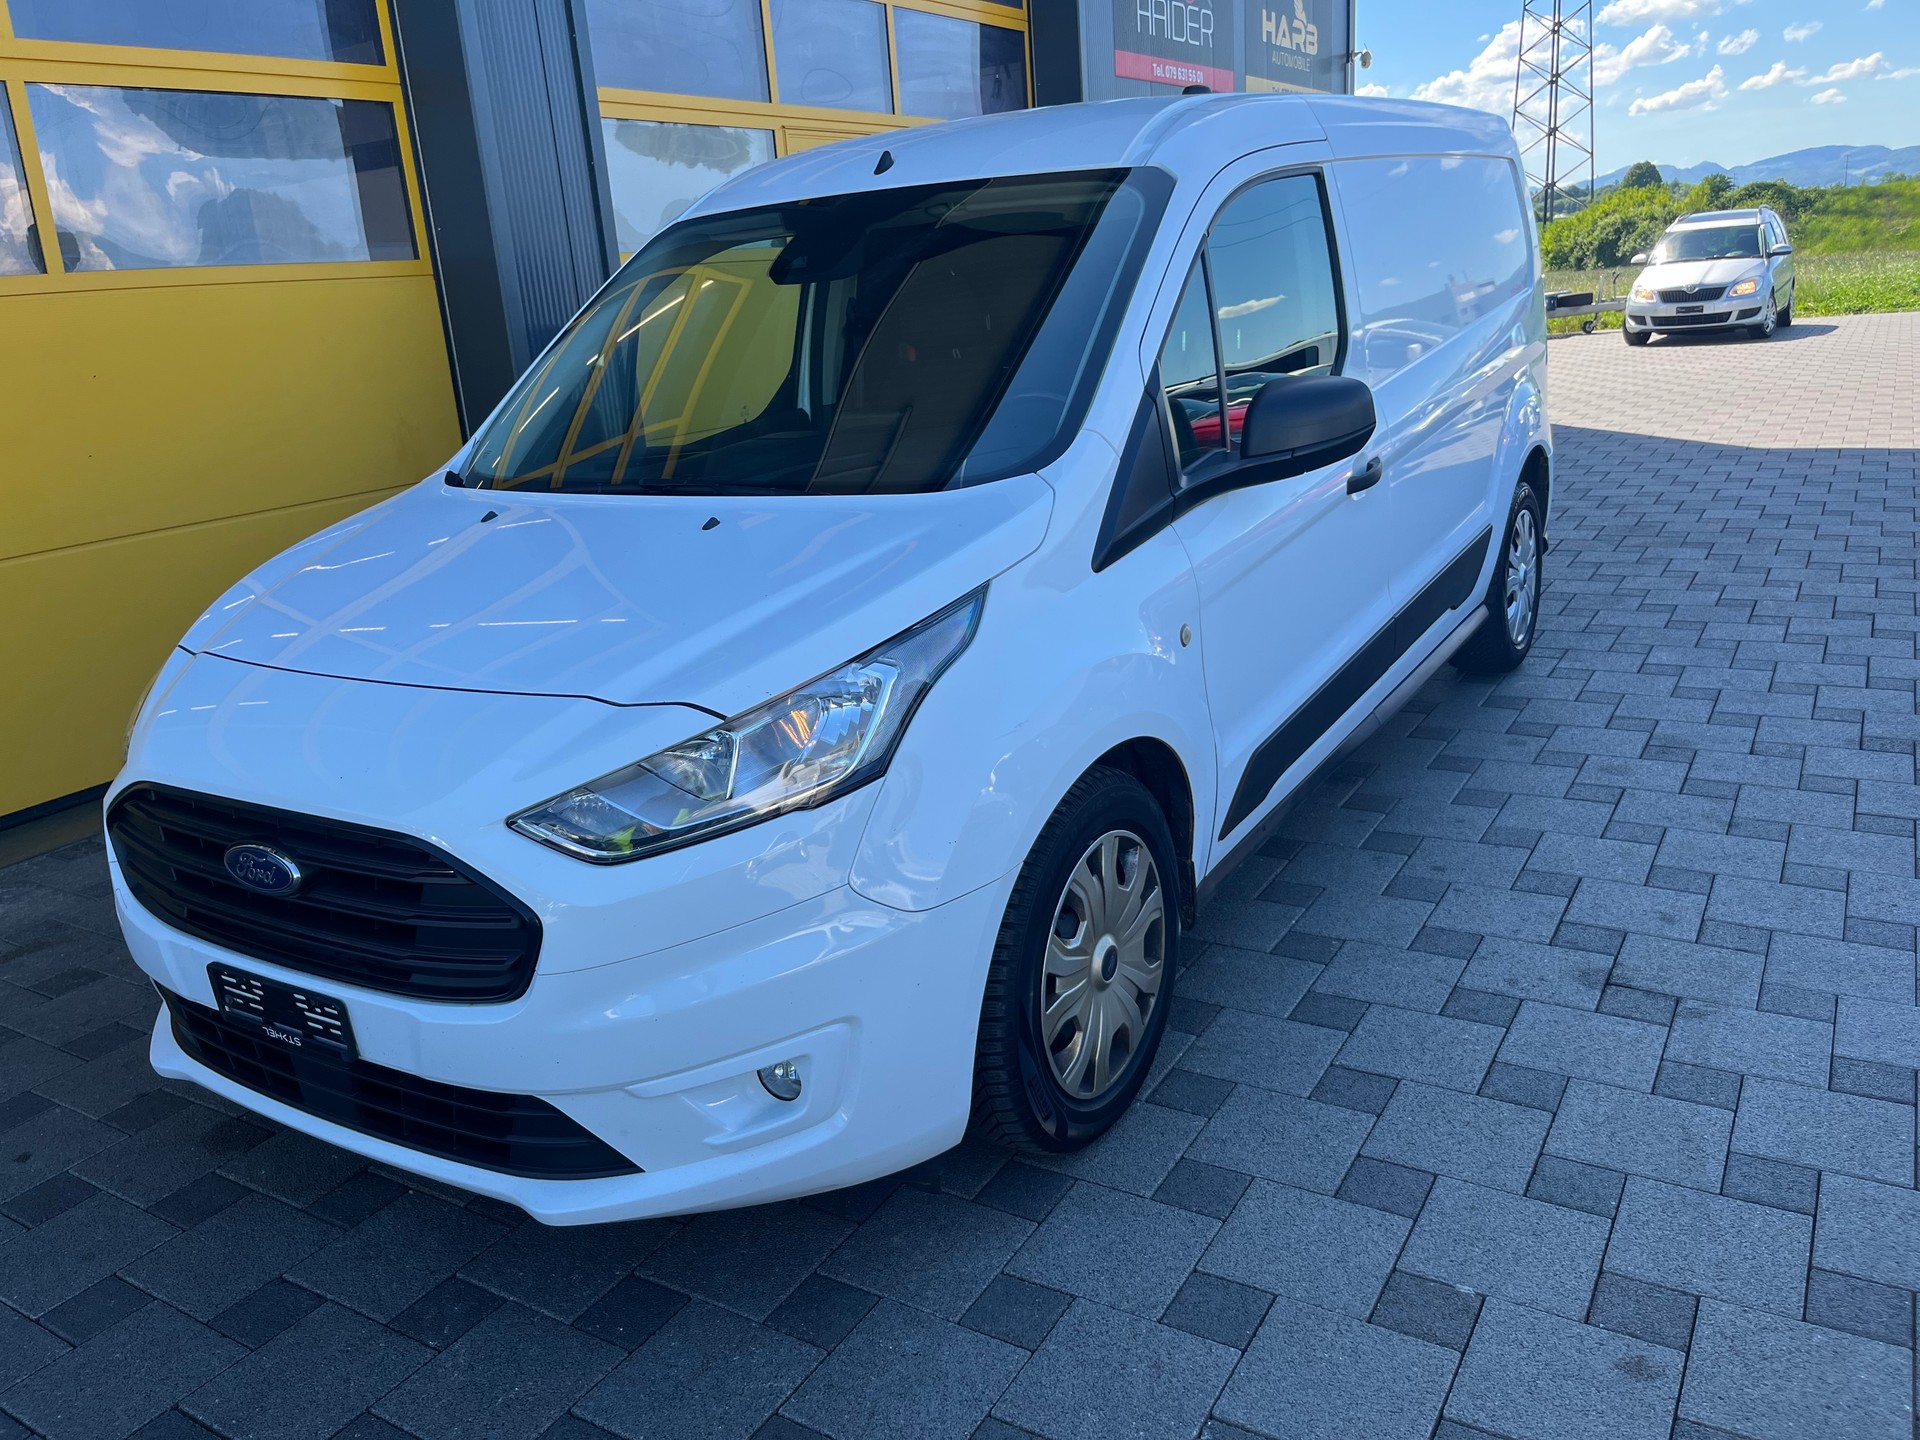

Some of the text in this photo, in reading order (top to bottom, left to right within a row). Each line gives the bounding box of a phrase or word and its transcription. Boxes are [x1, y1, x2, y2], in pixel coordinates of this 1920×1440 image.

[1136, 0, 1214, 48] HAIDER
[1262, 9, 1318, 55] HARB
[1152, 63, 1165, 77] Tel.
[1165, 64, 1177, 79] 079
[1177, 67, 1188, 81] 631
[1271, 50, 1311, 72] AUTOMOBILE
[236, 852, 277, 884] Ford
